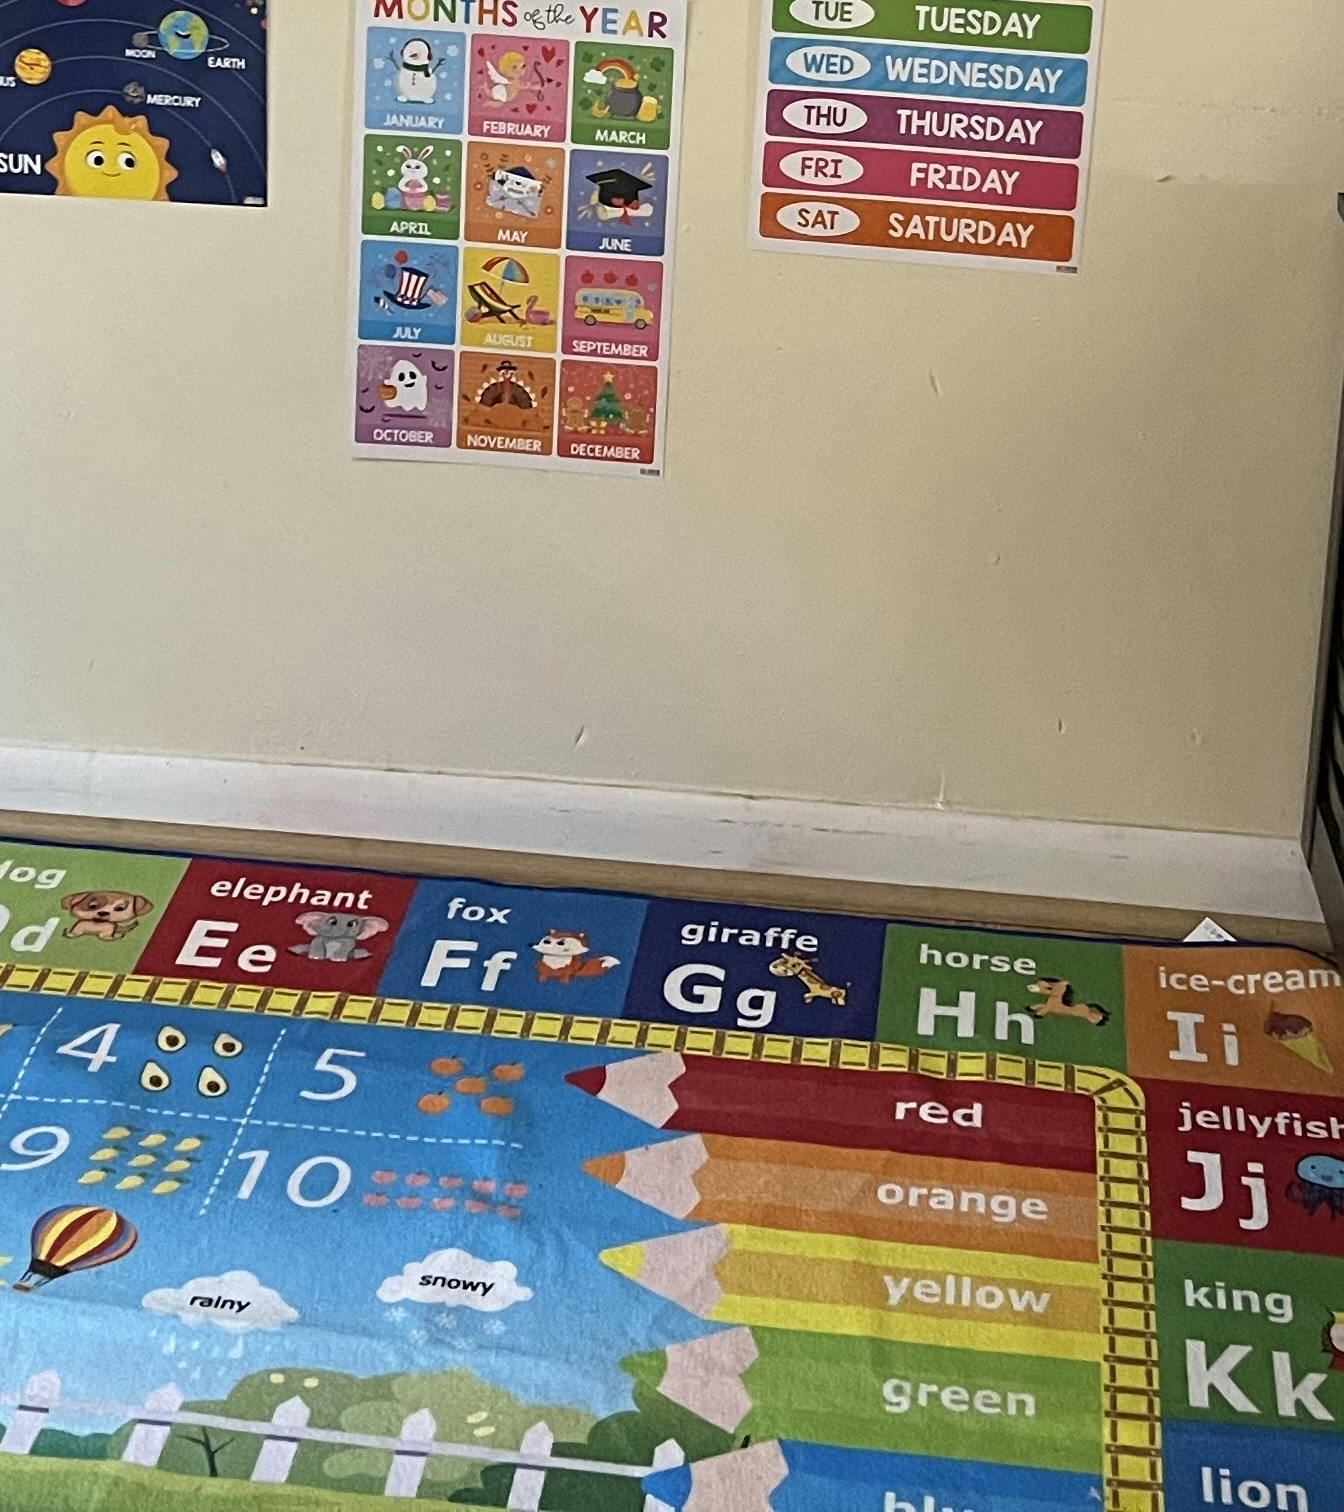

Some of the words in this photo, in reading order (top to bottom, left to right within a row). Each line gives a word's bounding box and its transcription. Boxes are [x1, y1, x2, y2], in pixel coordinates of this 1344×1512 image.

[523, 8, 546, 30] of
[545, 3, 575, 26] the
[579, 5, 668, 39] YEAR
[811, 1, 853, 22] TUE
[914, 5, 1041, 39] TUESDAY
[207, 57, 245, 69] EARTH
[803, 52, 854, 74] WED
[885, 55, 1063, 94] WEDNESDAY
[146, 94, 201, 108] MERCURY
[383, 113, 445, 129] JANUARY
[483, 120, 551, 138] FEBRUARY
[595, 129, 646, 145] MARCH
[803, 104, 847, 126] THU
[897, 109, 1044, 145] THURSDAY
[801, 157, 843, 178] FRI
[910, 162, 1020, 195] FRIDAY
[390, 221, 432, 236] APRIL
[497, 229, 529, 244] MAY
[598, 238, 632, 253] JUNE
[797, 208, 840, 230] SAT
[888, 213, 1035, 248] SATURDAY
[392, 327, 422, 339] JULY
[572, 340, 648, 358] SEPTEMBER
[373, 429, 434, 443] OCTOBER
[467, 434, 541, 452] NOVEMBER
[570, 443, 640, 460] DECEMBER
[210, 877, 373, 910] elephant
[447, 896, 512, 924] fox
[175, 919, 277, 973] Ee
[680, 921, 819, 952] giraffe
[420, 939, 518, 992] Ff
[919, 943, 1037, 975] horse
[663, 963, 778, 1028] Gg
[1158, 967, 1342, 995] ice-cream
[917, 988, 1035, 1046] Hh
[1167, 1010, 1239, 1066] Ii
[56, 1022, 122, 1073] 4
[299, 1048, 366, 1101] 5
[895, 1101, 983, 1128] red
[0, 1126, 70, 1172] 9
[236, 1149, 352, 1208] 10
[877, 1183, 1049, 1223] orange
[1181, 1150, 1269, 1231] Jj
[188, 1292, 251, 1315] rainy
[418, 1273, 496, 1298] snowy
[882, 1274, 1051, 1314] yellow
[1184, 1279, 1294, 1323] king
[881, 1378, 1036, 1417] green
[1185, 1338, 1336, 1422] Kk
[1201, 1466, 1309, 1512] lion
